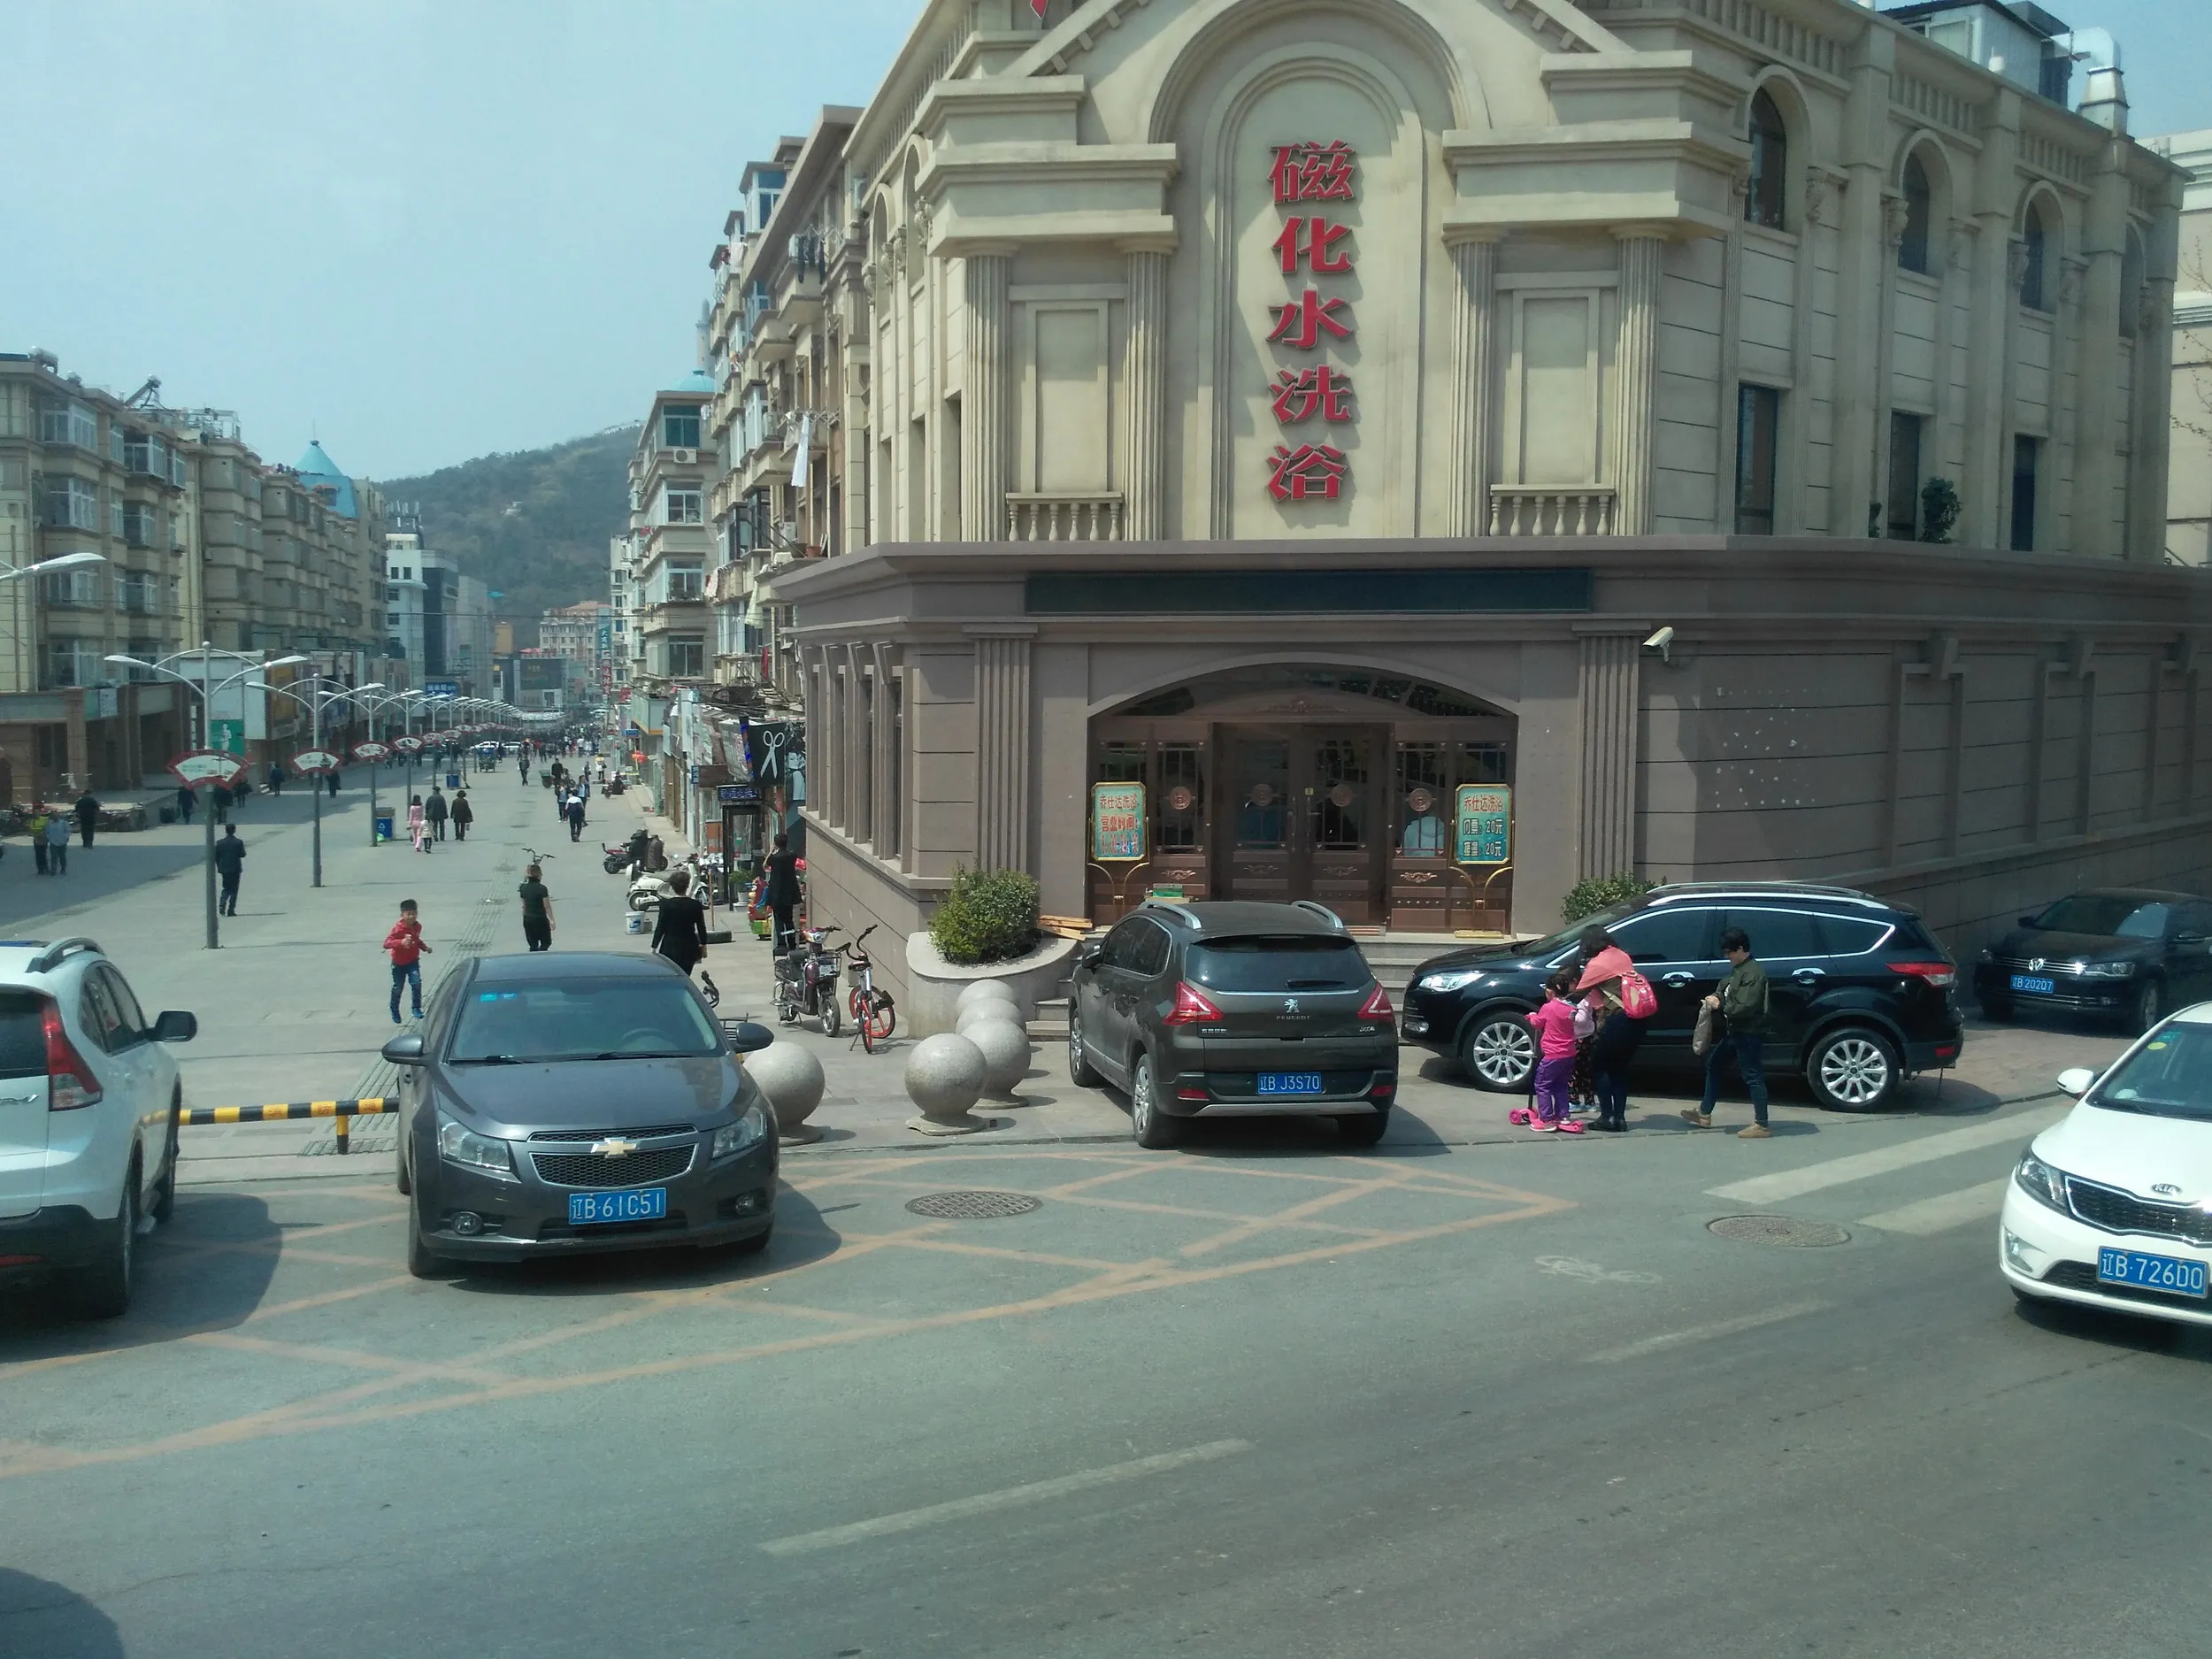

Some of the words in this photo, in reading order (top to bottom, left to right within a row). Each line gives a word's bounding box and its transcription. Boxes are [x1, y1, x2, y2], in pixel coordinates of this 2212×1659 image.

[1266, 139, 1355, 502] 磁化水洗浴
[1463, 793, 1502, 812] 乔仕达洗浴
[2154, 1184, 2177, 1193] KIA
